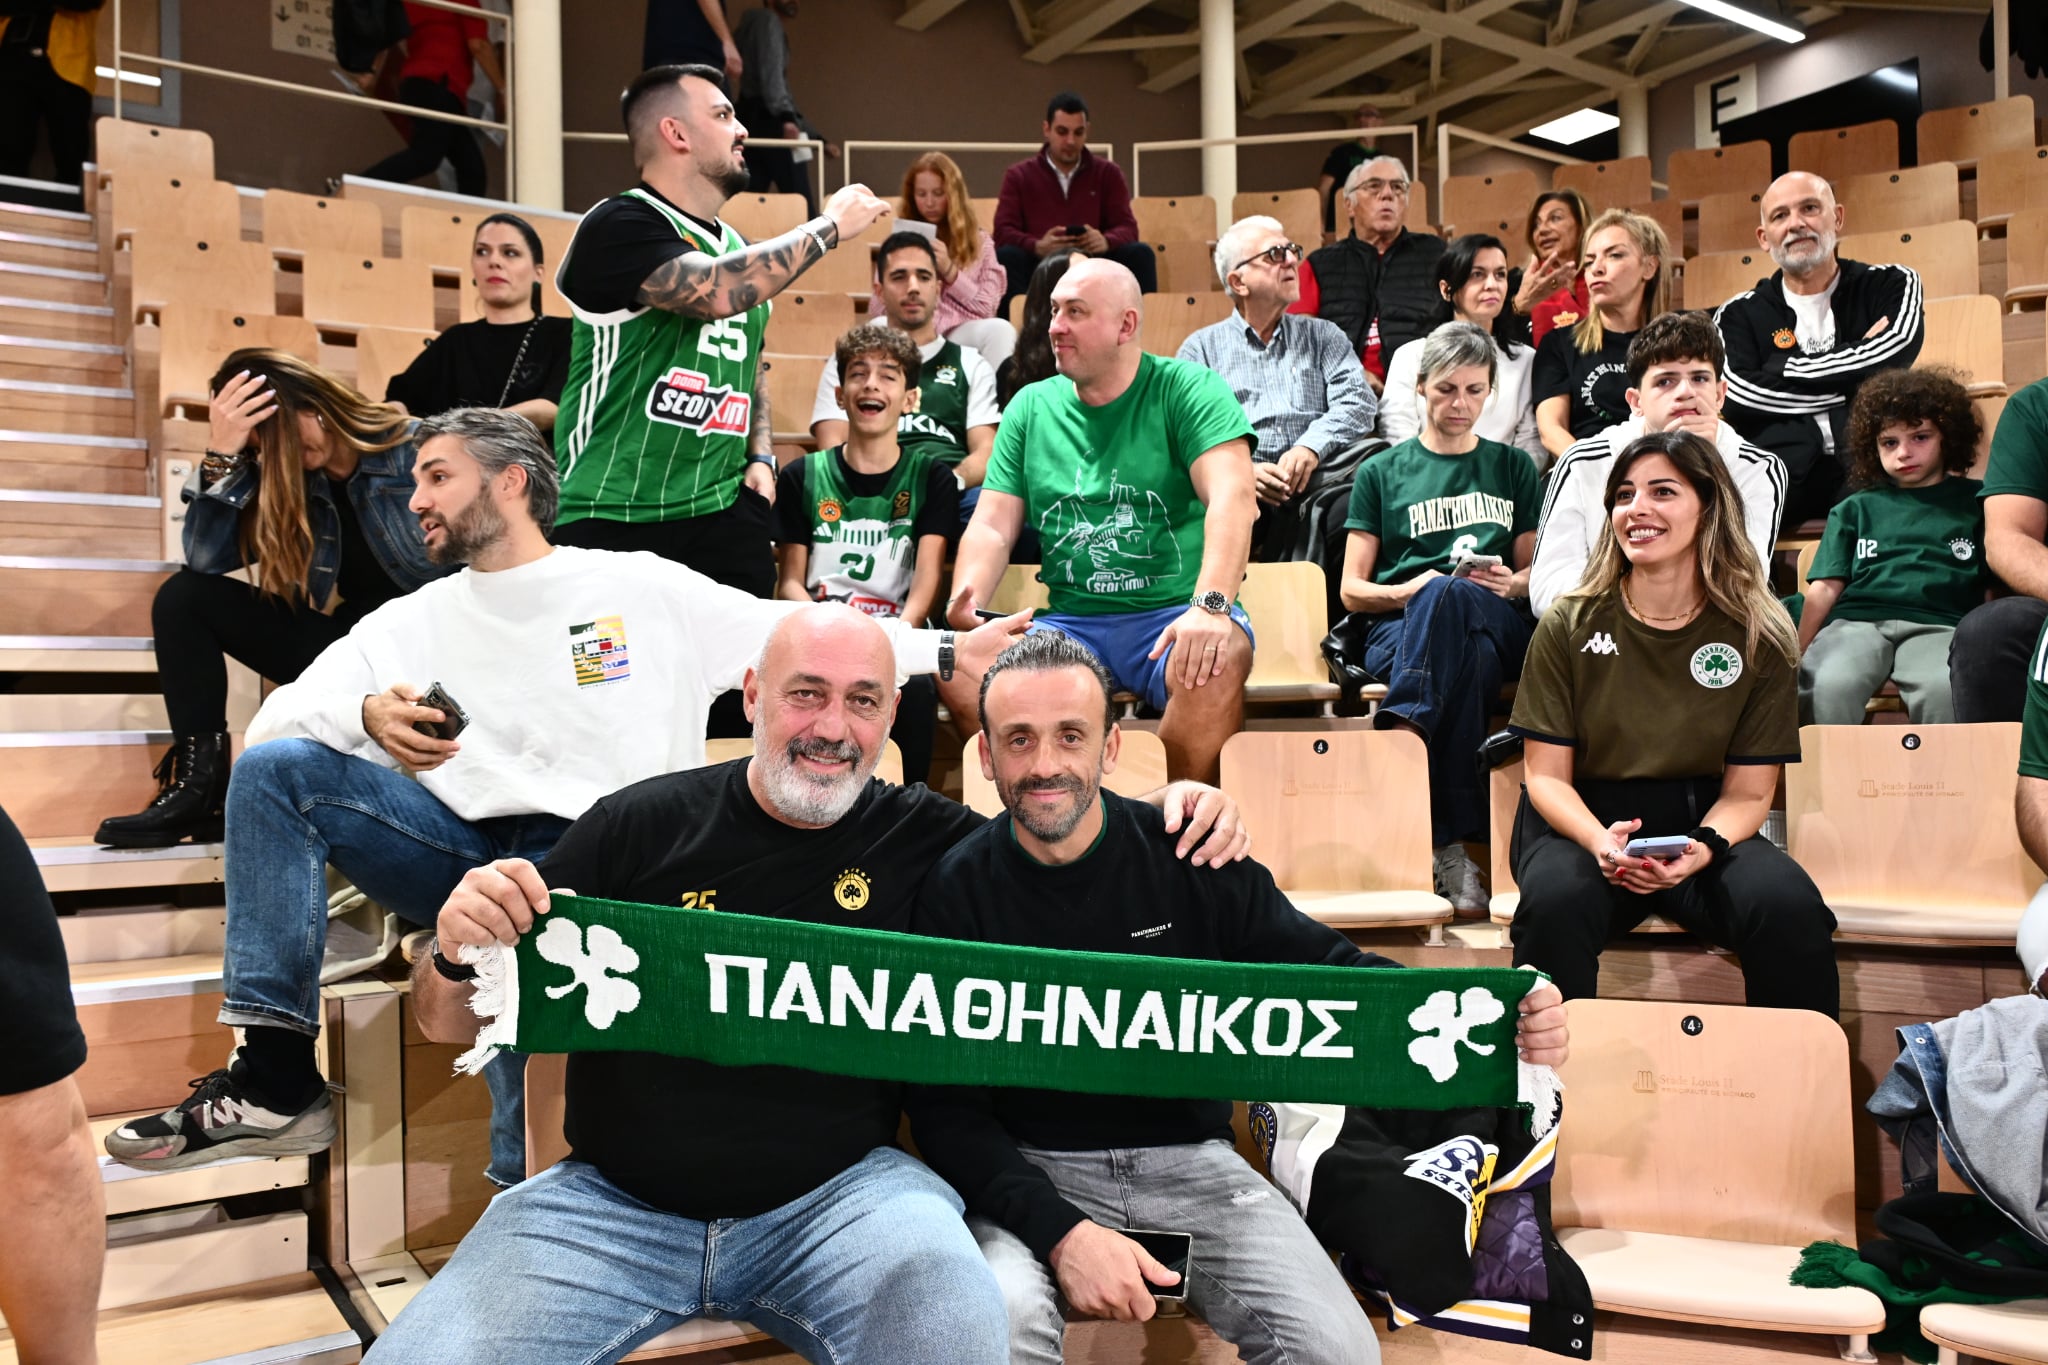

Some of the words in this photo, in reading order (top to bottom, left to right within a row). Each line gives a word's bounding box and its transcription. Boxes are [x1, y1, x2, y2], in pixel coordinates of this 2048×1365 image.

[697, 312, 748, 362] 25
[1408, 491, 1514, 539] PANATHINAIKOS
[1857, 538, 1878, 559] 02
[682, 890, 717, 912] 25
[704, 952, 1358, 1059] ΠΑΝΑΘΗΝΑΪΚΟΣ
